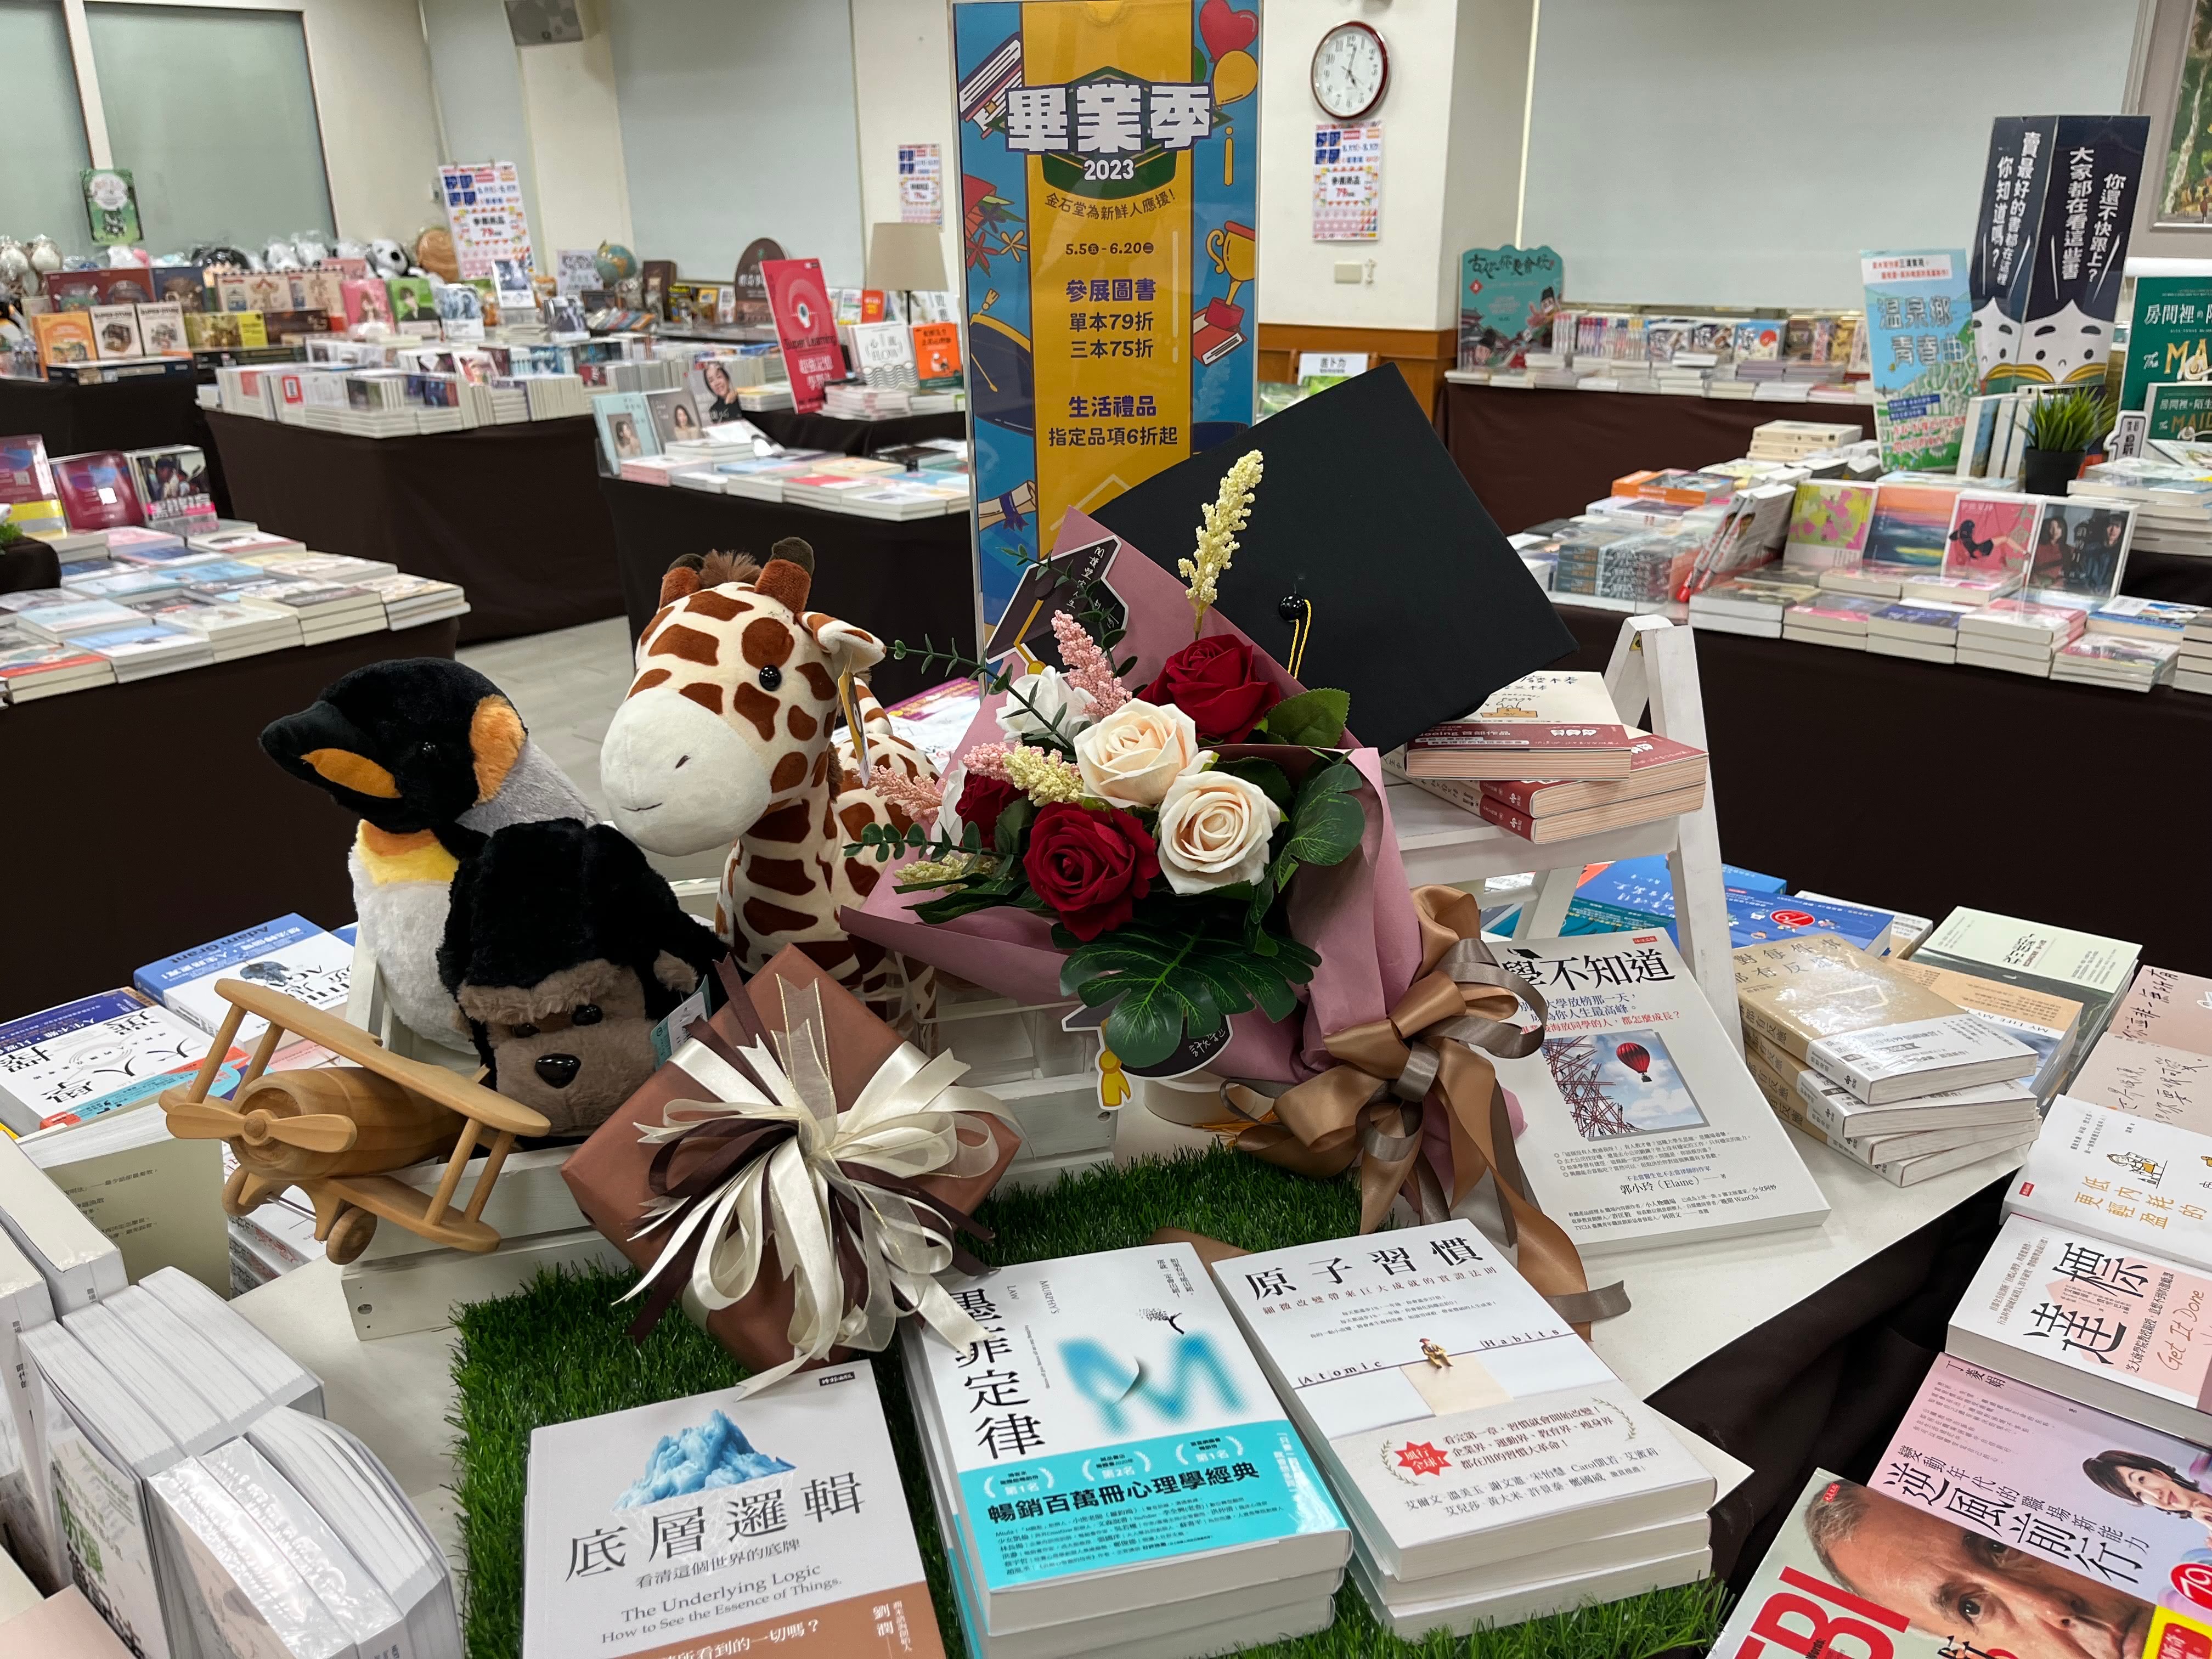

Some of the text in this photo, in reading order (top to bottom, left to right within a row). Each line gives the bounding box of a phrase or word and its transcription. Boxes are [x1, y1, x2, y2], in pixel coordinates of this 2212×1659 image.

[1008, 82, 1210, 153] 畢業季
[1084, 159, 1135, 180] 2023
[2062, 146, 2095, 280] 大家都在看這些書
[1065, 278, 1156, 303] 參展圖書
[1069, 311, 1154, 332] 單本79折
[1070, 338, 1154, 359] 三本75折
[1048, 426, 1178, 447] 指定品項6折起
[1068, 396, 1157, 419] 生活禮品
[167, 925, 269, 964] Adam Grant
[40, 1037, 189, 1103] 大人學
[1244, 1236, 1485, 1301] 原子習慣
[2023, 1242, 2149, 1365] 達標
[2157, 1340, 2186, 1371] Get
[2172, 1290, 2204, 1323] Done
[1301, 1327, 1561, 1386] Atomic Habits
[1945, 1360, 2007, 1389] 丁菱娟
[1405, 1446, 1430, 1462] 風行
[988, 1461, 1260, 1524] 暢銷百萬冊心理學經典
[1897, 1444, 2150, 1555] 變動年代的職場新能力
[565, 1471, 867, 1583] 底層邏輯
[1882, 1461, 2143, 1584] 逆風前行
[620, 1564, 822, 1623] The Underlying Logic
[635, 1538, 800, 1590] 看清這個世界的底牌
[601, 1578, 843, 1644] How to See the Essence of Things.
